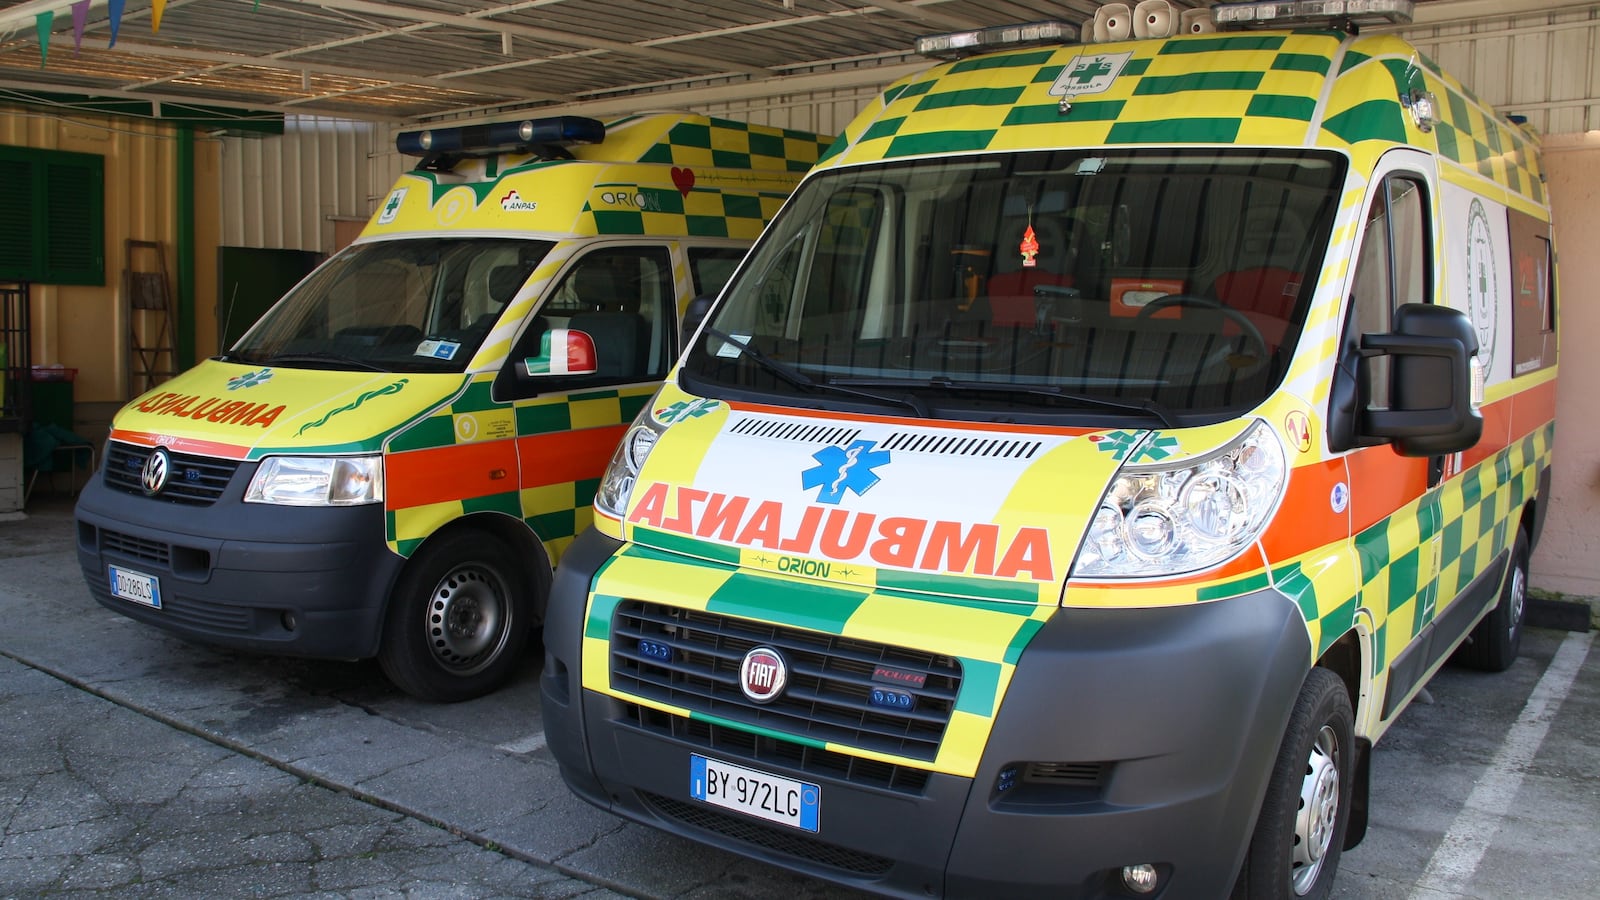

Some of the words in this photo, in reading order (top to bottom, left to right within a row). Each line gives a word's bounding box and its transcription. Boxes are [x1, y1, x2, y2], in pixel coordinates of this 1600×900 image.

[446, 200, 460, 218] 9
[509, 202, 537, 210] ANPAS
[601, 191, 661, 211] ORION
[463, 421, 471, 434] 9
[1288, 416, 1310, 446] 14
[777, 556, 831, 578] ORION
[749, 662, 776, 688] FIAT
[874, 669, 925, 683] POWER
[707, 768, 730, 799] BY
[736, 776, 799, 817] 972LG
